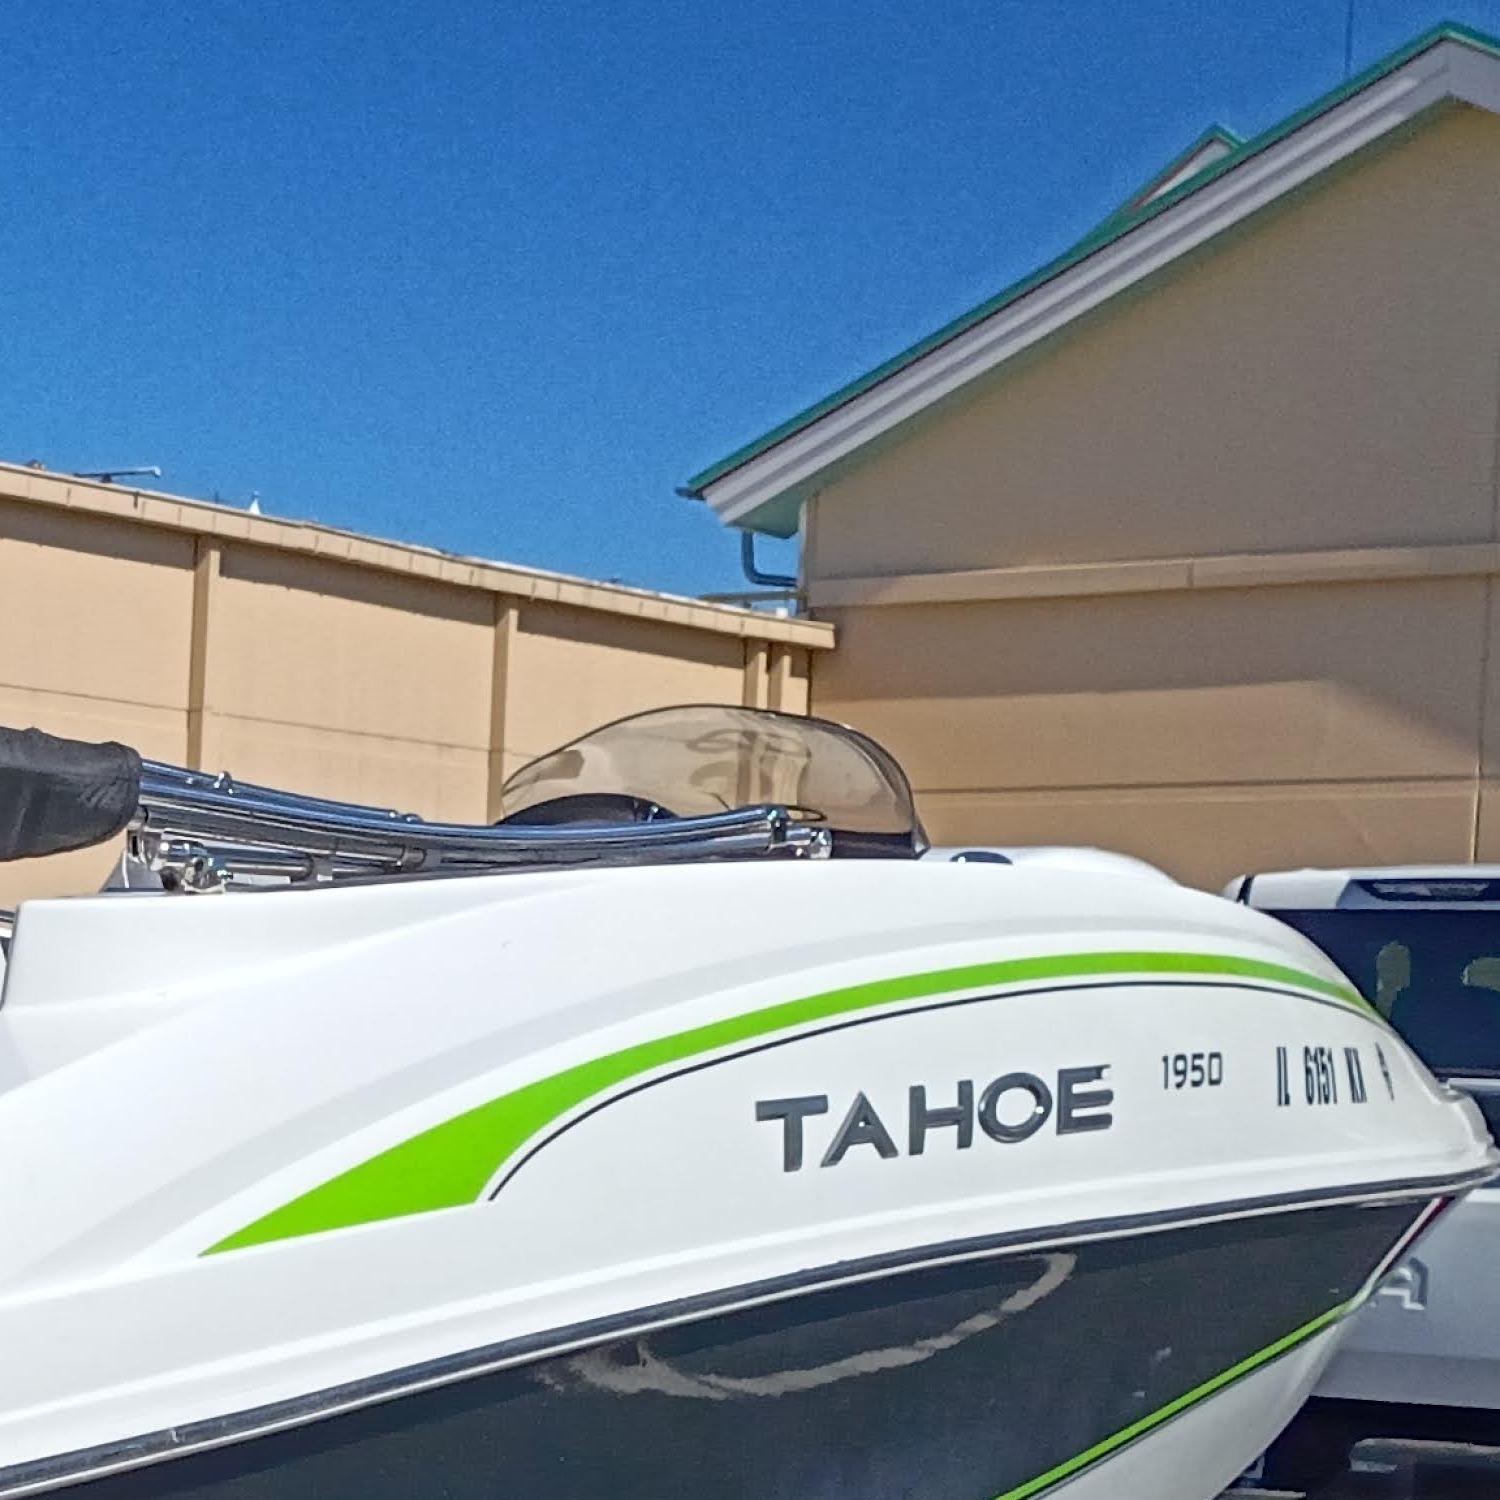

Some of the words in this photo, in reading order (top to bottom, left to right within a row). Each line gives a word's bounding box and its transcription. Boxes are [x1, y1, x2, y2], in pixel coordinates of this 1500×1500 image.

[1162, 1051, 1223, 1090] 1950
[1276, 1046, 1290, 1106] IL
[755, 1064, 1114, 1173] TAHOE
